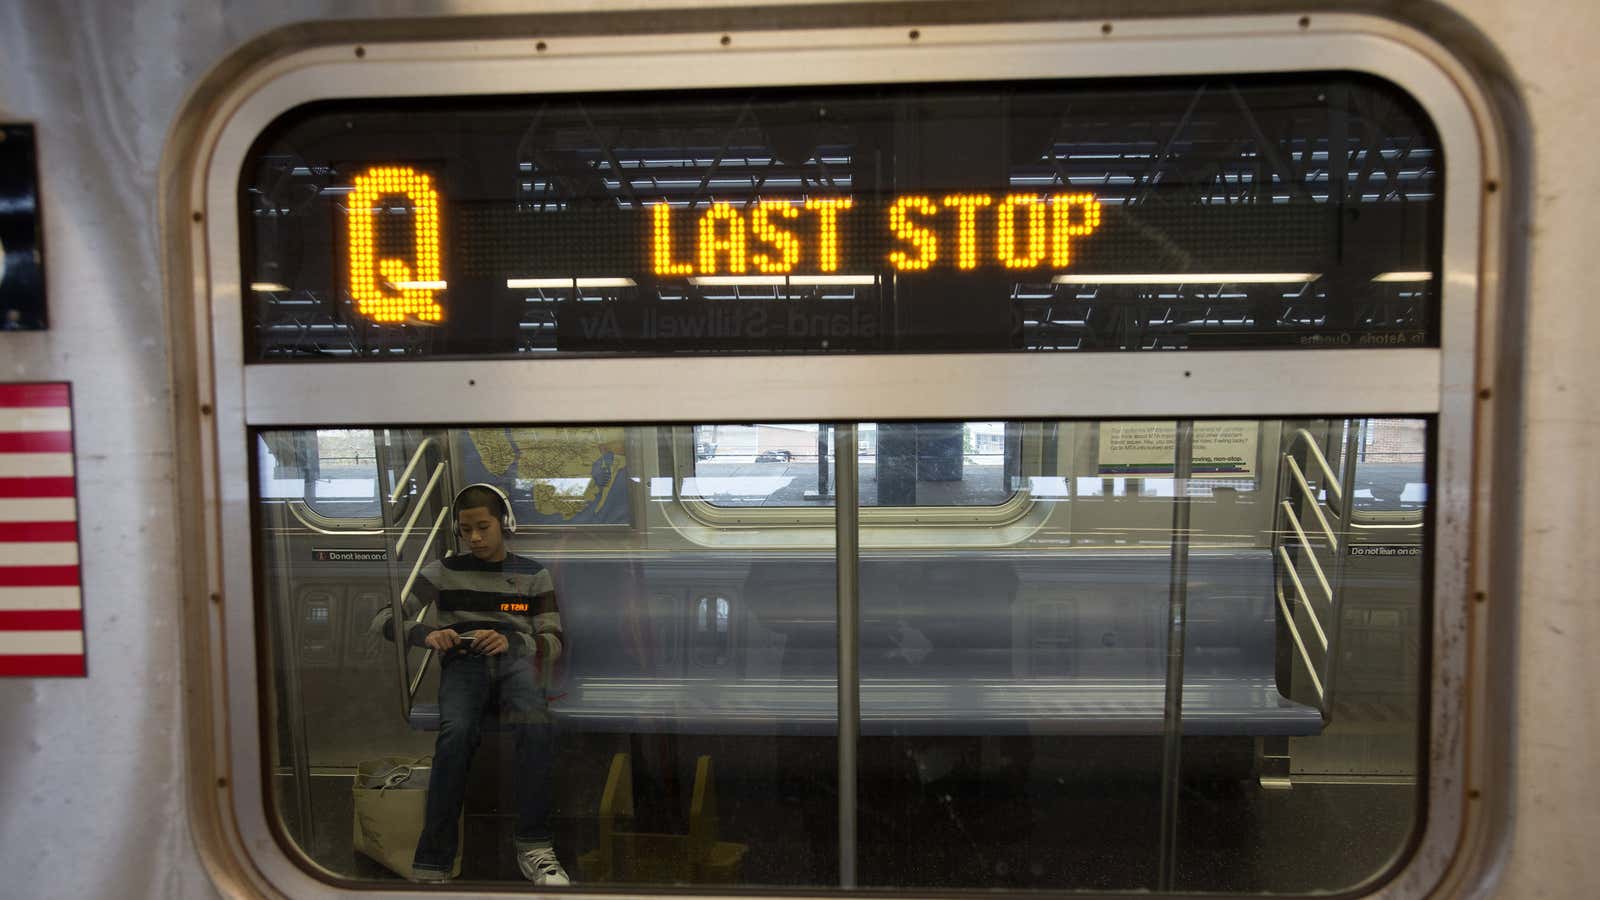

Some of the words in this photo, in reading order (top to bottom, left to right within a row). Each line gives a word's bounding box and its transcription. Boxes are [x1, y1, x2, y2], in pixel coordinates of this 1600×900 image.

[346, 165, 446, 323] Q
[651, 197, 853, 277] LAST
[888, 192, 1101, 271] STOP
[329, 552, 341, 560] Do
[341, 552, 354, 560] not
[355, 552, 371, 560] lean
[1351, 547, 1364, 555] Do
[1365, 547, 1379, 555] not
